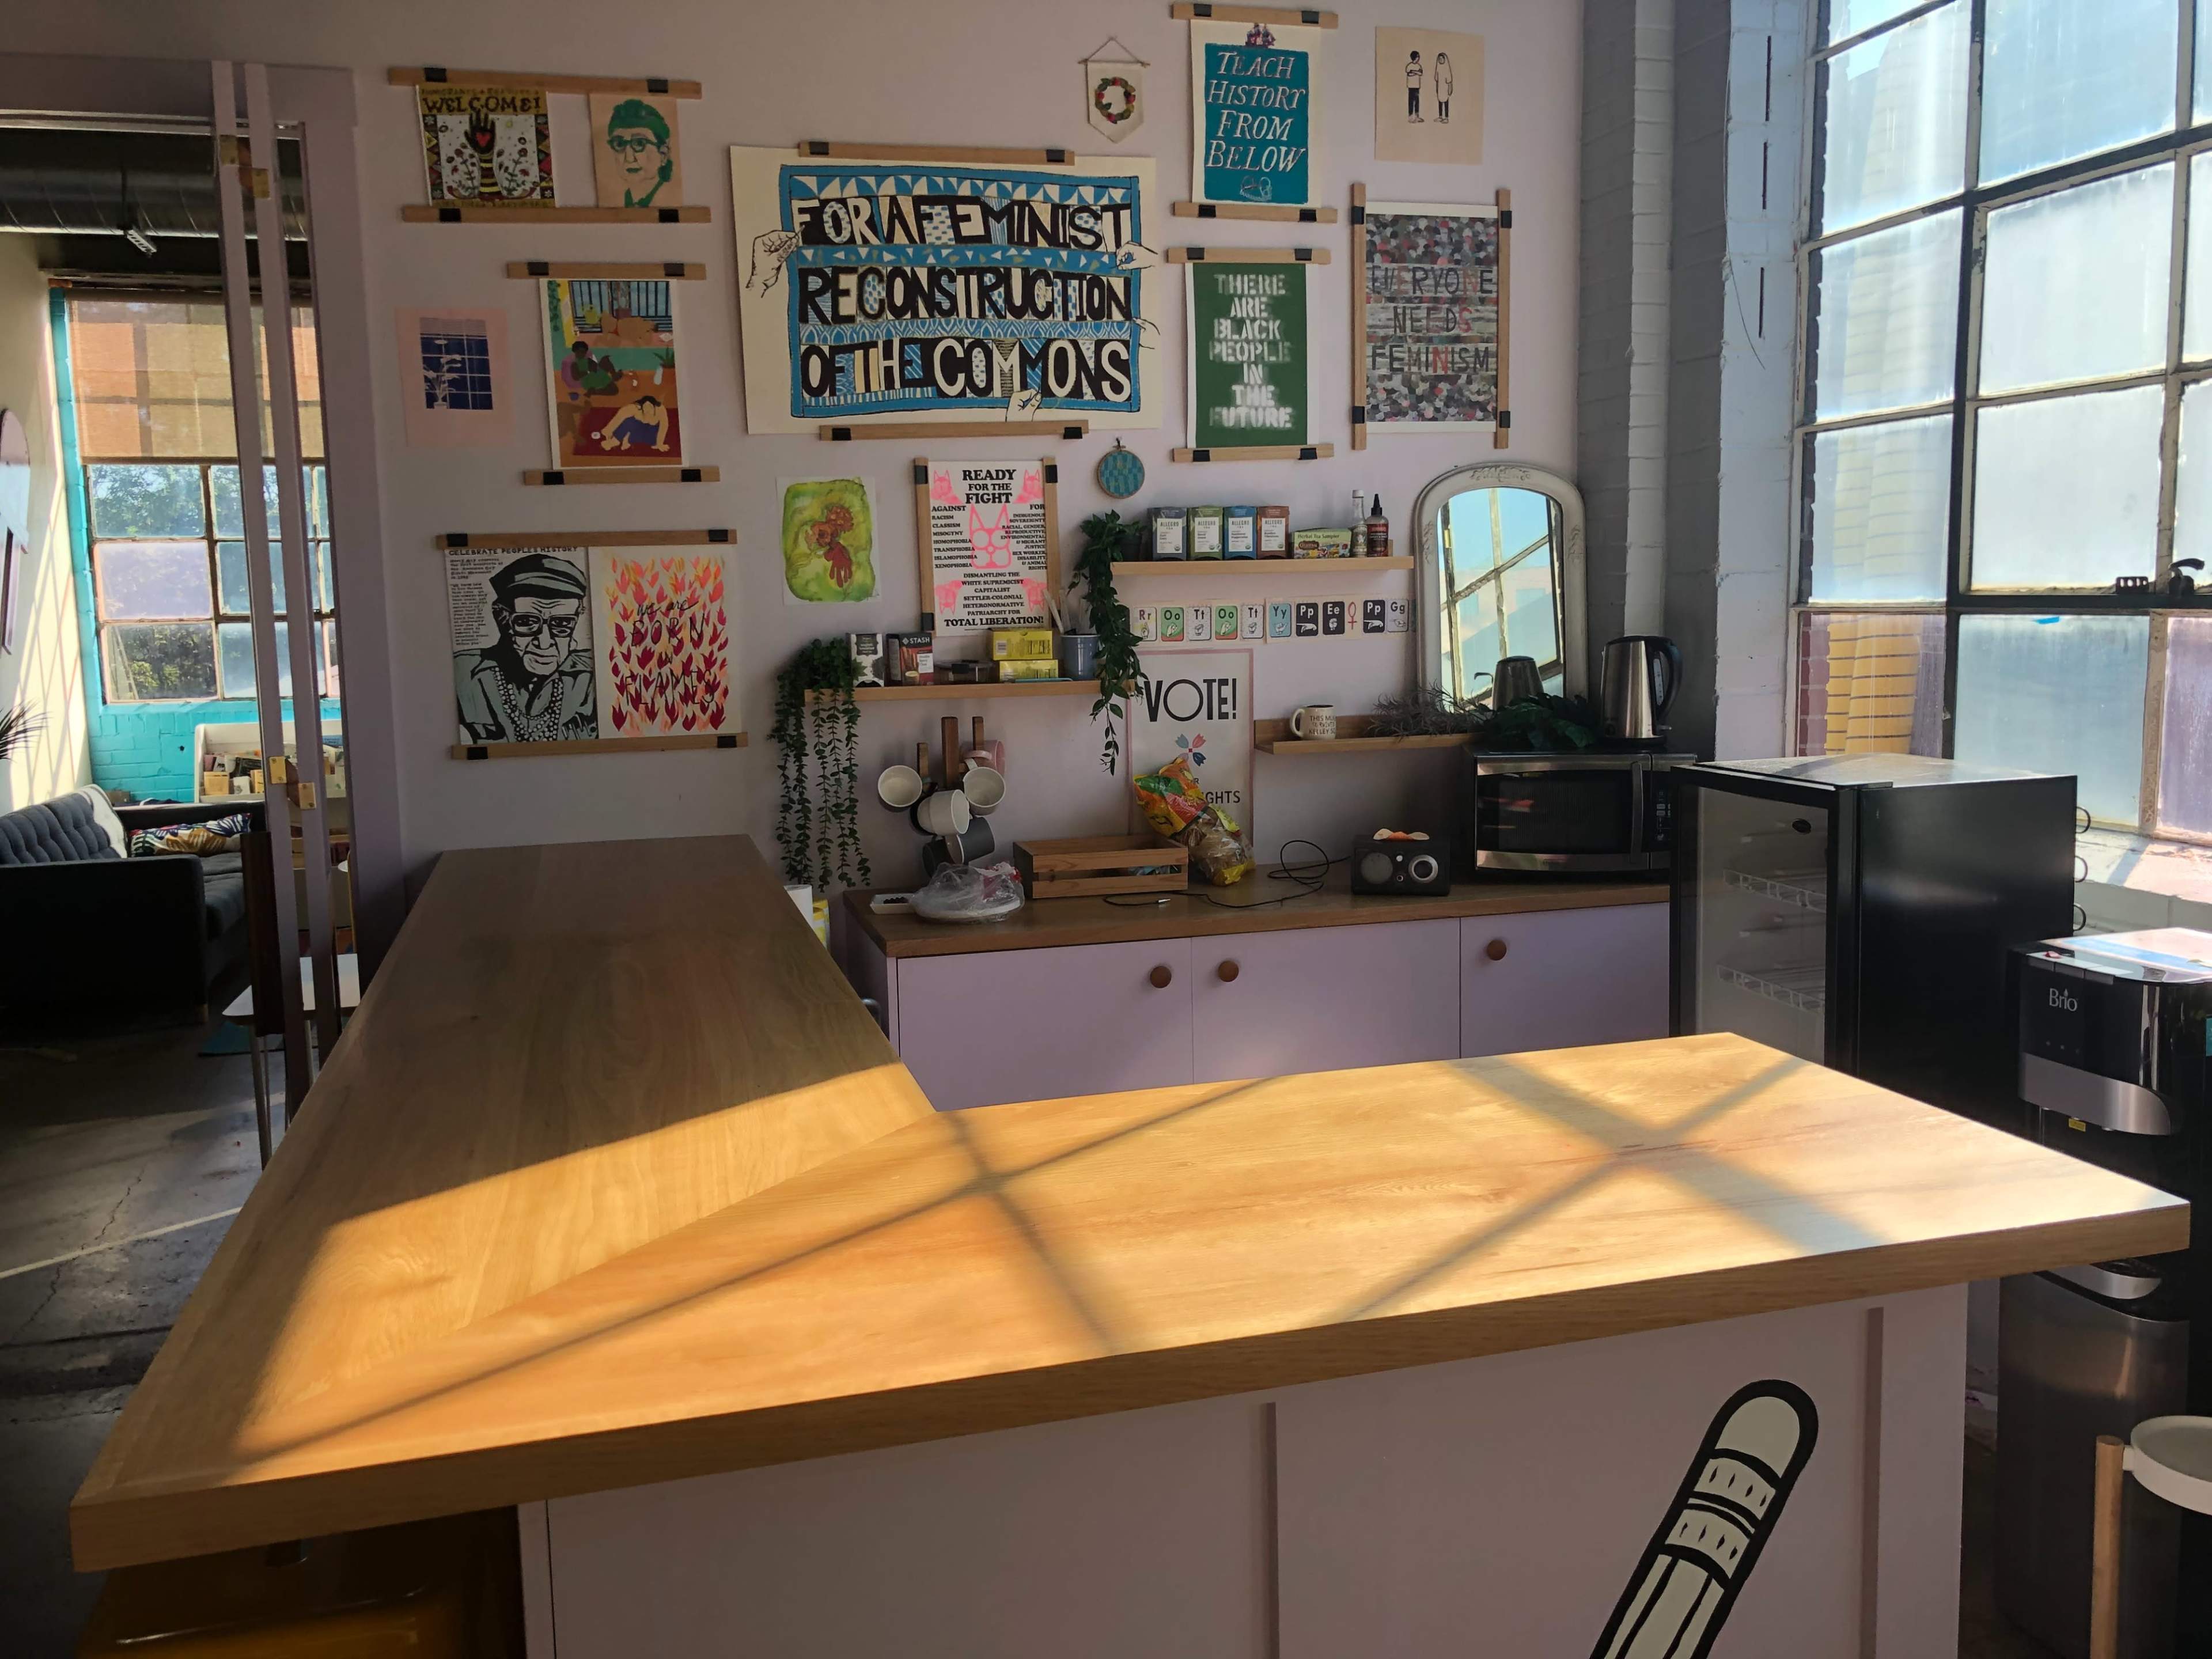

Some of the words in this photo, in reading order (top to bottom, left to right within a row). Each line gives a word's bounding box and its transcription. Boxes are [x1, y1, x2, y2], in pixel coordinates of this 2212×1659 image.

[1217, 51, 1295, 79] TEACH
[422, 96, 541, 115] WELCOME!
[1207, 80, 1305, 110] HISTORY
[1216, 109, 1294, 141] FROM
[1206, 140, 1306, 172] BELOW
[791, 198, 881, 246] FOR
[916, 197, 1131, 253] FEMINIST
[1214, 274, 1286, 295] THERE
[1372, 266, 1493, 295] EVERYONE
[799, 266, 1131, 324] RECONSTRUCTION
[1230, 297, 1268, 317] ARE
[1213, 318, 1281, 340] BLACK
[1393, 305, 1472, 334] NEEDS
[1209, 340, 1291, 362] PEOPLE
[1372, 344, 1489, 374] FEMINISM
[801, 344, 853, 397] OF
[933, 337, 1131, 402] COMMONS
[1243, 362, 1263, 385] IN
[1232, 384, 1275, 406] THE
[1209, 406, 1293, 429] FUTURE
[962, 469, 1017, 481] READY
[968, 483, 989, 491] FOR
[991, 483, 1012, 491] THE
[965, 493, 1013, 504] FIGHT
[449, 548, 498, 556] CELEBRATE
[637, 603, 661, 616] we
[666, 600, 699, 611] are
[1139, 609, 1152, 620] Rr
[1273, 605, 1287, 619] Yy
[1300, 605, 1314, 619] Pp
[1327, 604, 1340, 615] Ee
[1367, 602, 1381, 615] Pp
[1391, 601, 1405, 614] Gg
[630, 613, 705, 646] BORN
[944, 619, 978, 627] TOTAL
[979, 616, 1044, 626] LIBERATION!
[909, 636, 930, 644] STASH
[625, 668, 715, 706] FLAMES
[1143, 678, 1237, 722] VOTE!
[1202, 790, 1241, 804] GHTS
[2049, 987, 2078, 1012] Brio
